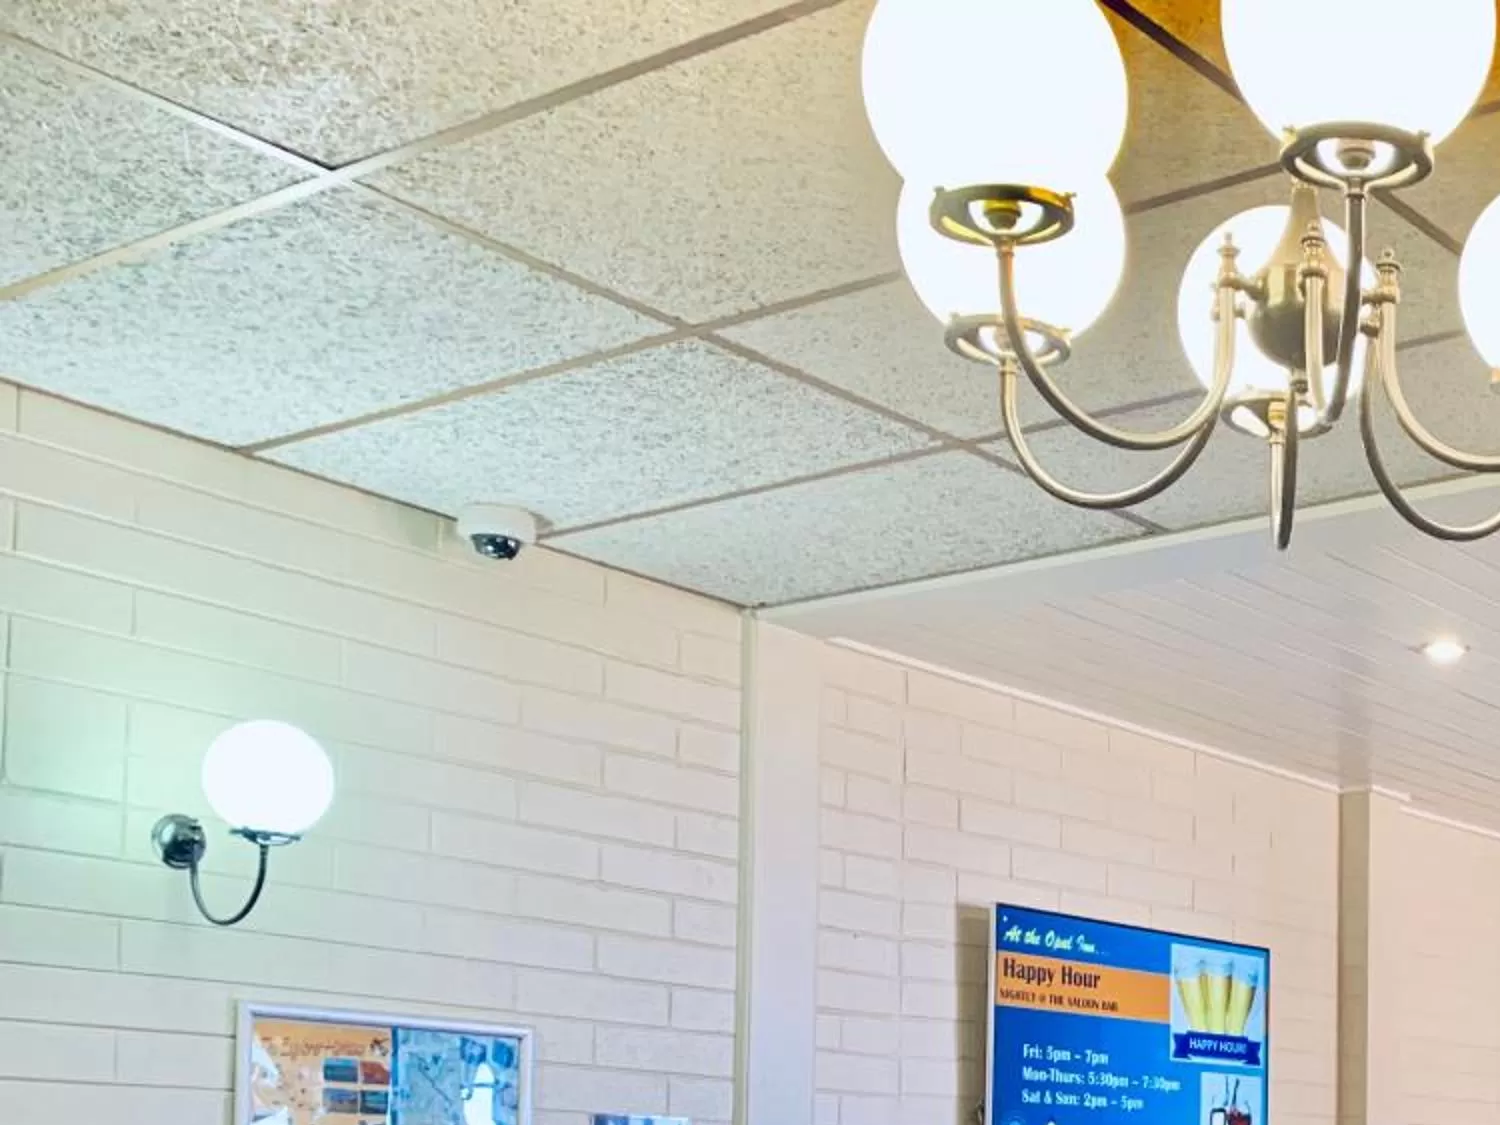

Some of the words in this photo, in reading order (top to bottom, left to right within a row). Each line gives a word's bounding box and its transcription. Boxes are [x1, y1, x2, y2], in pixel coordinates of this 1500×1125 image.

[1023, 928, 1041, 945] the
[1045, 930, 1073, 950] Opal
[1003, 957, 1057, 987] Happy
[1061, 965, 1101, 988] Hour
[1050, 993, 1064, 1006] THE
[1101, 1001, 1119, 1013] BAR
[1023, 1043, 1043, 1060] Fri:
[1046, 1046, 1071, 1063] 5pm
[1084, 1049, 1109, 1066] 7pm
[1189, 1037, 1218, 1052] HAPPY
[1022, 1066, 1085, 1084] Mon-Thurs:
[1087, 1072, 1129, 1088] 5:30pm
[1142, 1075, 1182, 1093] 7:30pm
[1021, 1088, 1041, 1104] Sat
[1044, 1090, 1053, 1104] &
[1055, 1091, 1081, 1106] Sun:
[1083, 1092, 1108, 1109] 2pm
[1120, 1095, 1145, 1112] 5pm
